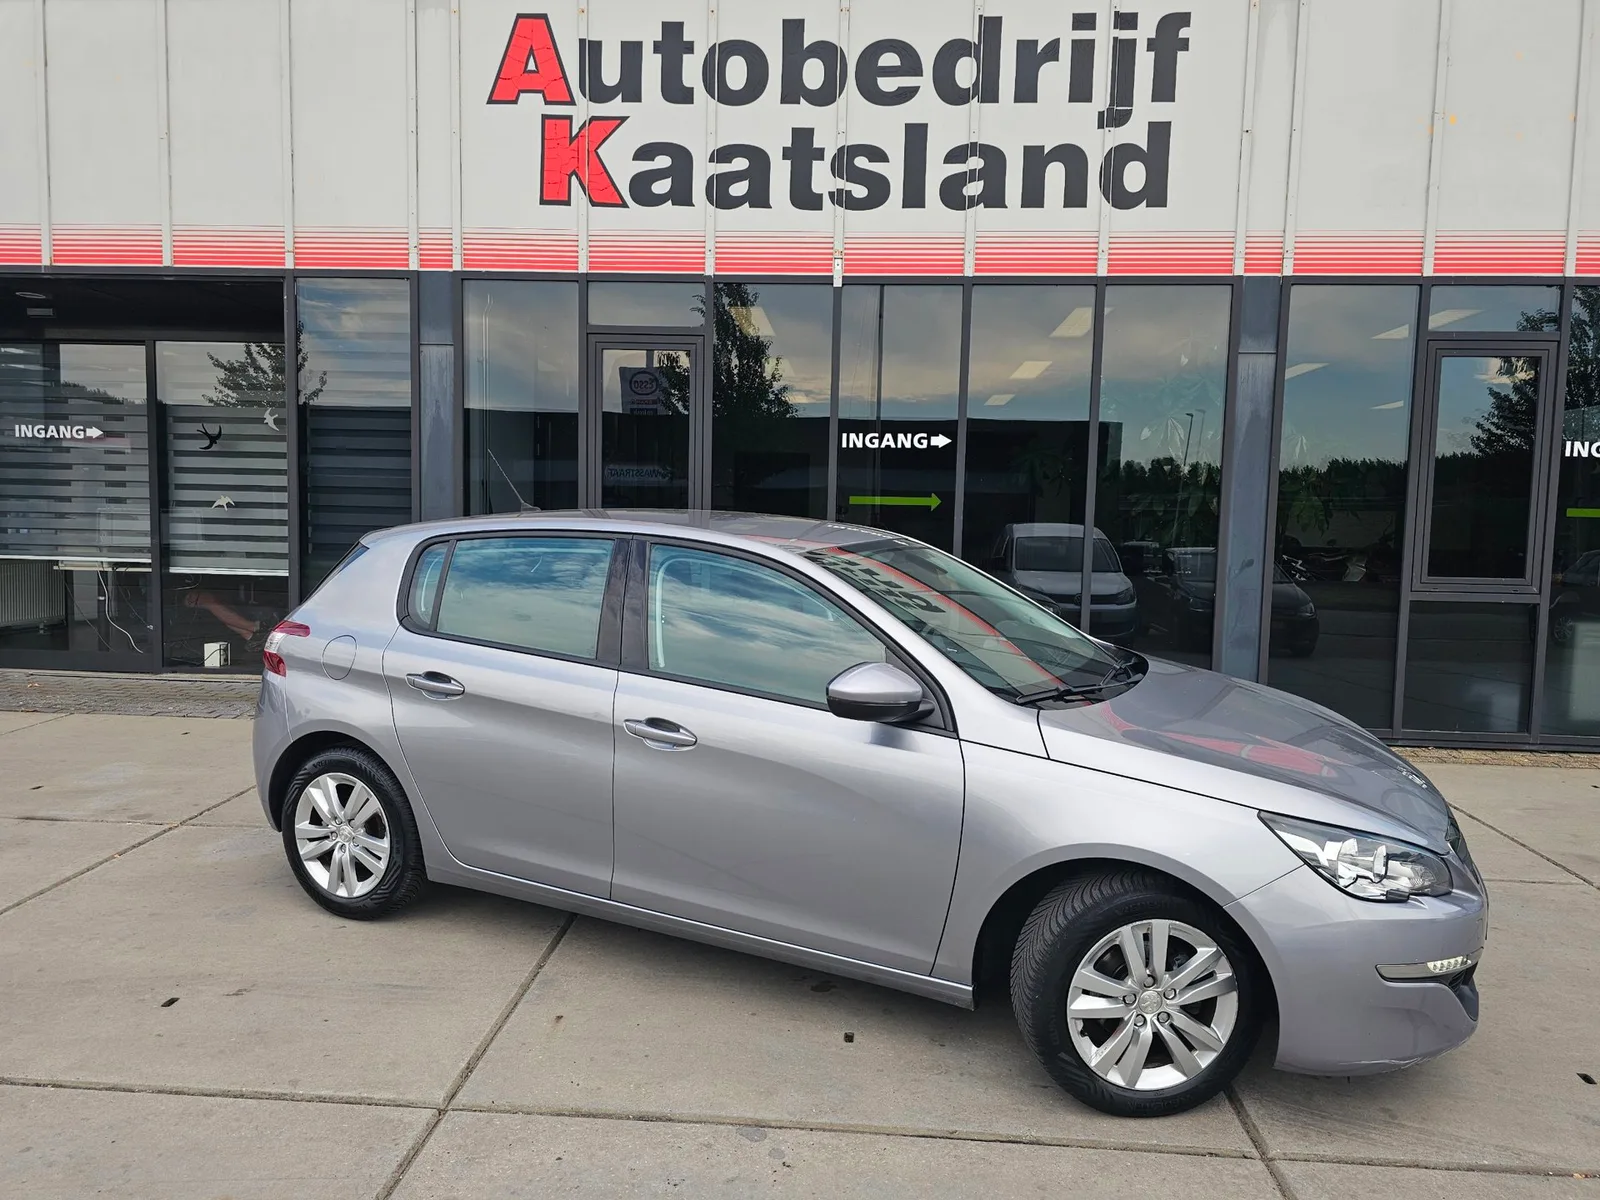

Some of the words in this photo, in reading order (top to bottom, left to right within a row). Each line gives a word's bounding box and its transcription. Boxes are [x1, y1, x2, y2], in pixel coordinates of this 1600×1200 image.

[486, 11, 1192, 129] Autobedrijf
[539, 114, 1173, 211] Kaatsland
[15, 424, 85, 439] INGANG
[841, 432, 928, 449] INGANG
